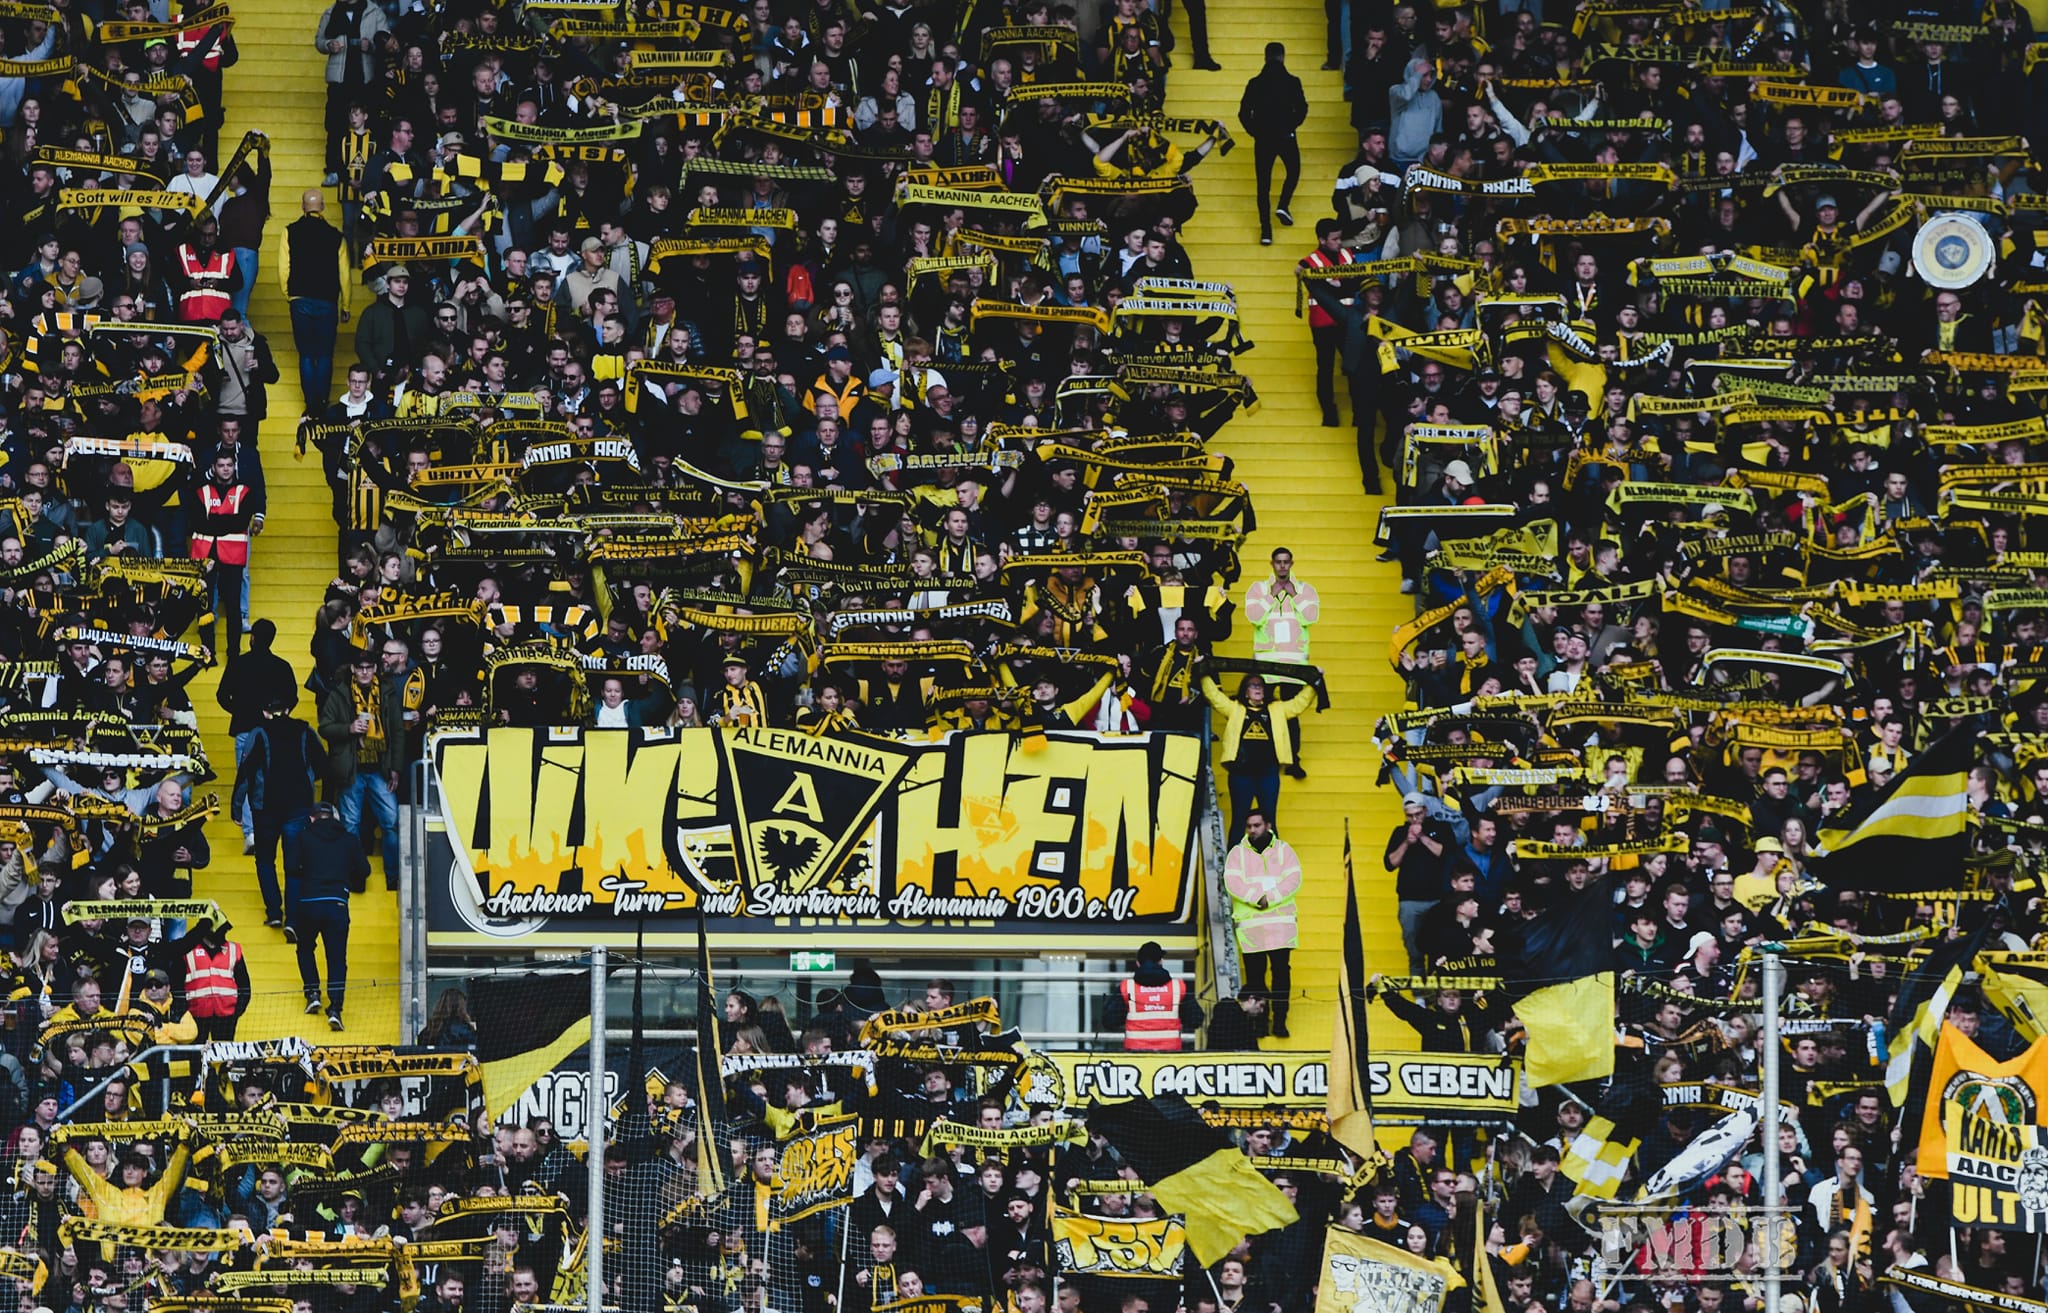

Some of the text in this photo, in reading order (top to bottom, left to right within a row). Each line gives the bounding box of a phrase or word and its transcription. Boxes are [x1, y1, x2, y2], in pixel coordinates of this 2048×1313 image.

[567, 21, 627, 32] ALEMANNIA
[1892, 21, 1990, 35] ALEMANNIA
[509, 125, 567, 138] ALEMANNIA
[75, 193, 105, 204] Gott
[109, 190, 133, 203] will
[136, 193, 152, 204] es
[912, 189, 1039, 208] ALEMANNIA AACHEN
[753, 209, 788, 219] AACHEN
[1371, 262, 1411, 273] AACHEN
[1176, 279, 1198, 289] TSV
[1151, 301, 1174, 311] DER
[1179, 301, 1204, 312] TSV
[1137, 355, 1166, 365] never
[1169, 353, 1194, 364] walk
[1640, 398, 1706, 413] ALEMANNIA
[1447, 428, 1470, 438] TSV
[643, 491, 661, 502] ist
[668, 490, 702, 502] Kraft
[1624, 486, 1741, 502] ALEMANNIA AACHEN
[1176, 522, 1219, 535] Aachen
[838, 578, 975, 593] You'll never walk alone
[73, 707, 127, 726] Aachen
[163, 729, 194, 737] VEREIN
[733, 727, 887, 777] ALEMANNIA
[1487, 774, 1556, 785] AACHEN
[772, 771, 825, 822] A
[486, 875, 1139, 920] Aachener Turn- und Sportverein Alemannia 1900 e.V.
[87, 903, 209, 915] ALEMANNIA AACHEN
[882, 1010, 918, 1027] BAD
[1075, 1062, 1512, 1099] FÜR AACHEN ALS GEBEN!
[1960, 1108, 2024, 1163] KARLS
[1957, 1158, 2016, 1184] AAC
[1953, 1182, 2024, 1225] ULT
[1907, 1270, 1994, 1305] KARLSBANDE
